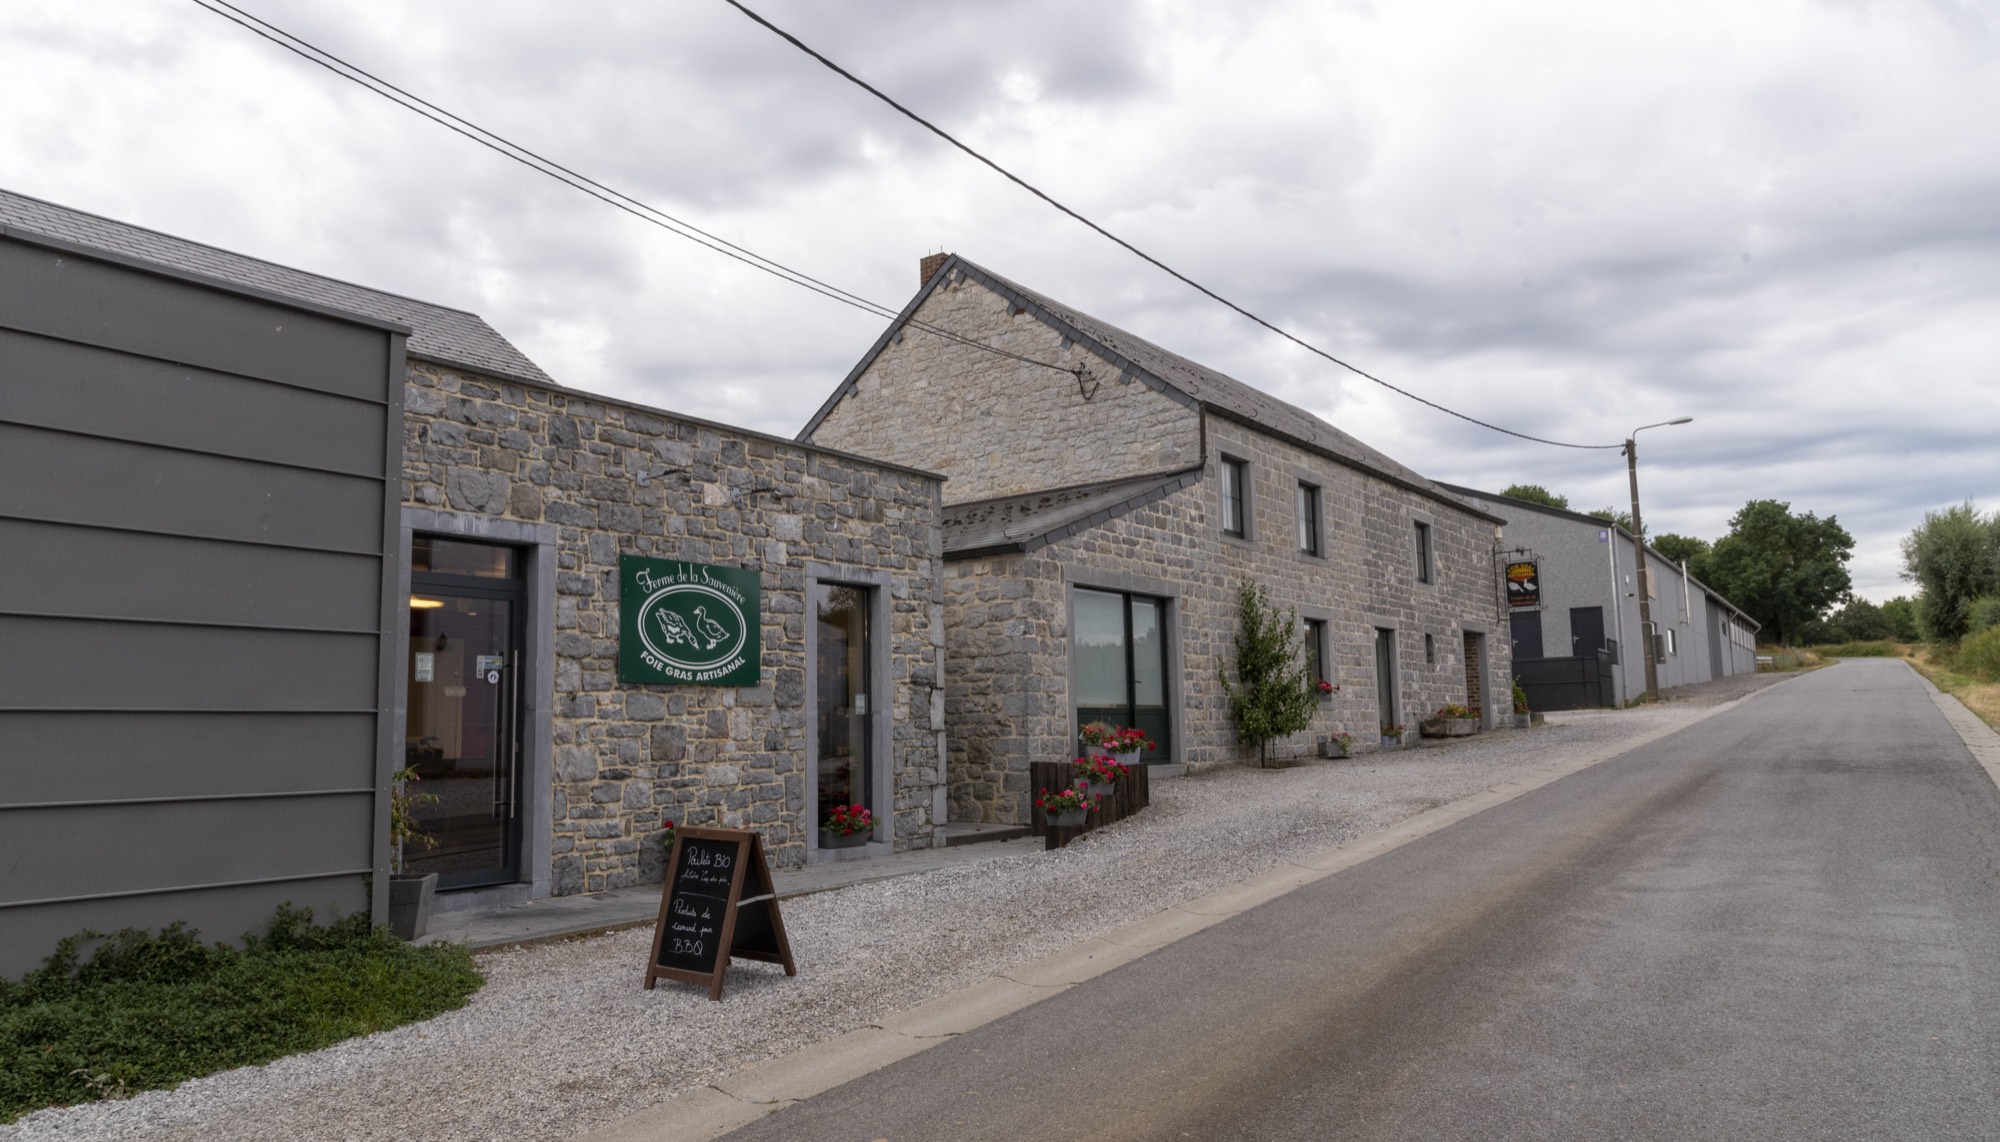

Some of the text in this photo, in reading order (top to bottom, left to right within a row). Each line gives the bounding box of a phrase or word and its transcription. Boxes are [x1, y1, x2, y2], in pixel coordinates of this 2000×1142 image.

[636, 563, 746, 605] Ferme de la Sauvenière
[640, 650, 746, 681] FOIE GRAS ARTISANAL
[700, 906, 712, 919] de
[671, 938, 703, 956] BBQ
